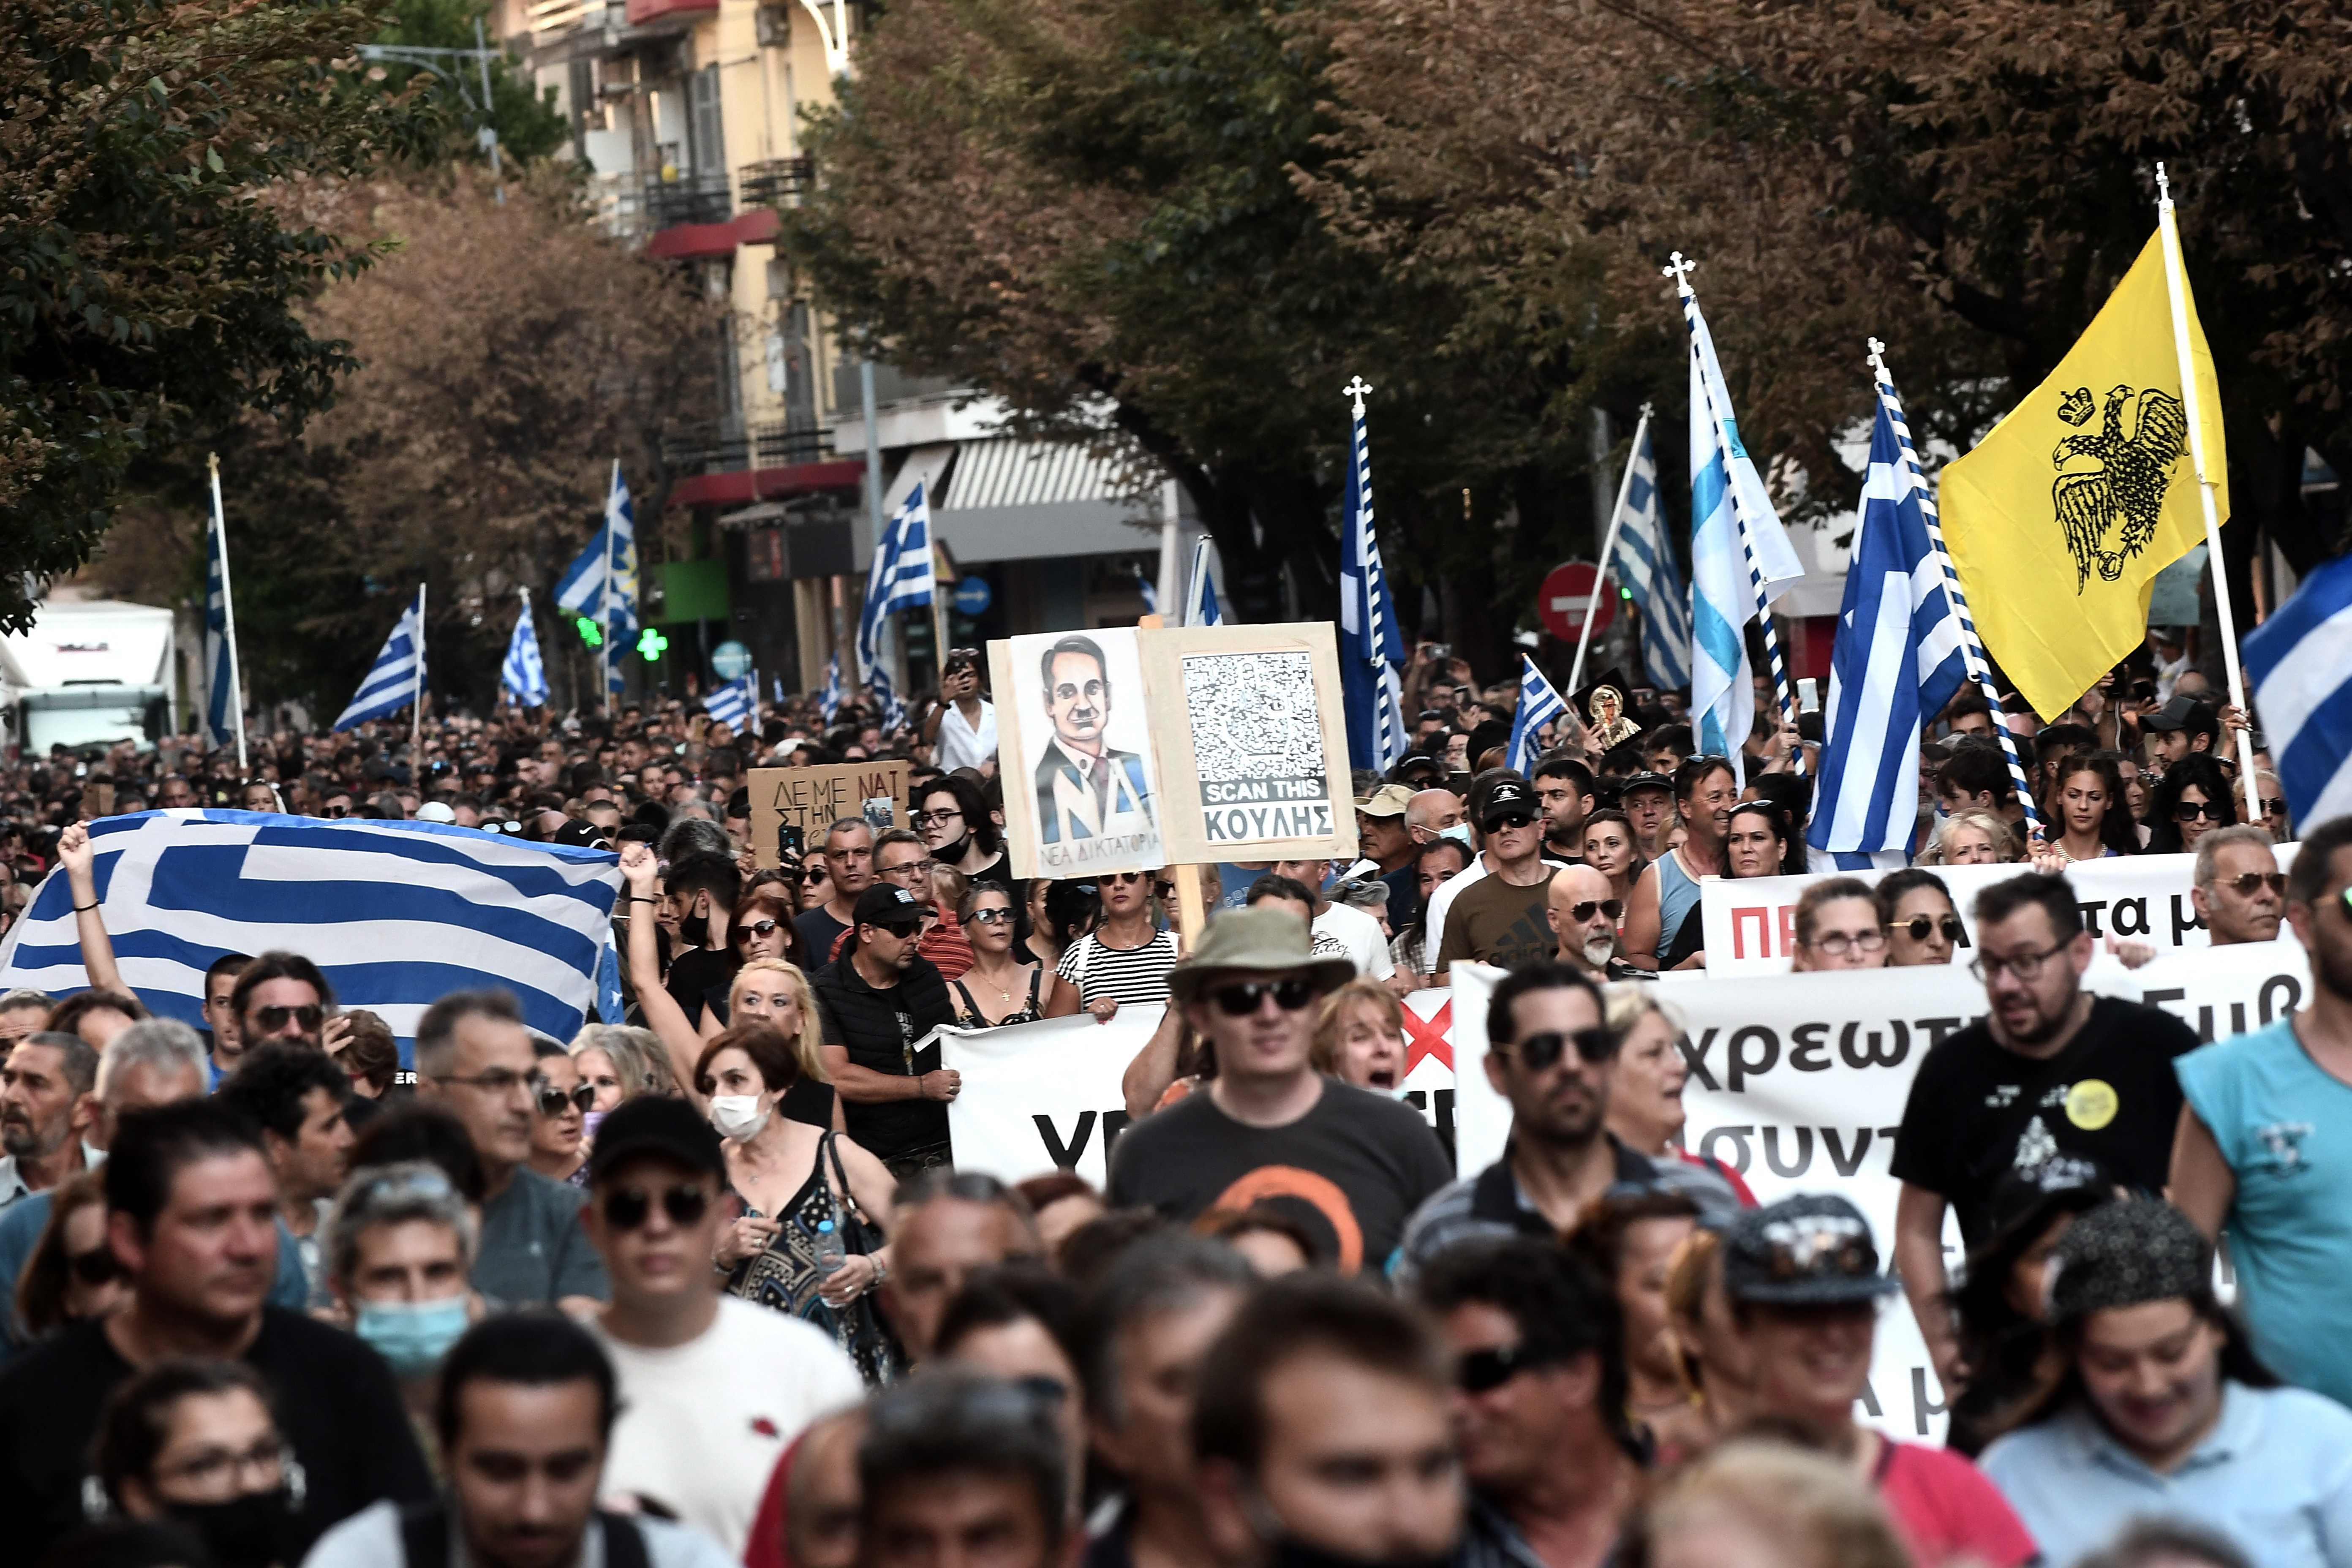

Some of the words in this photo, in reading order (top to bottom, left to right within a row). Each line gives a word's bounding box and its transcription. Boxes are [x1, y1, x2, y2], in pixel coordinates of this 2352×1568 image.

[858, 770, 900, 802] ΝΑΙ
[1206, 782, 1268, 802] SCAN
[1272, 779, 1321, 798] THIS
[775, 803, 837, 827] ΣΤΗΝ
[1204, 806, 1333, 841] ΚΟΥΛΗΣ
[1040, 844, 1073, 866] ΝΕΑ
[1078, 832, 1160, 861] ΔΙΚΤΑΤΟΡΙΑ
[2170, 894, 2209, 947] μ
